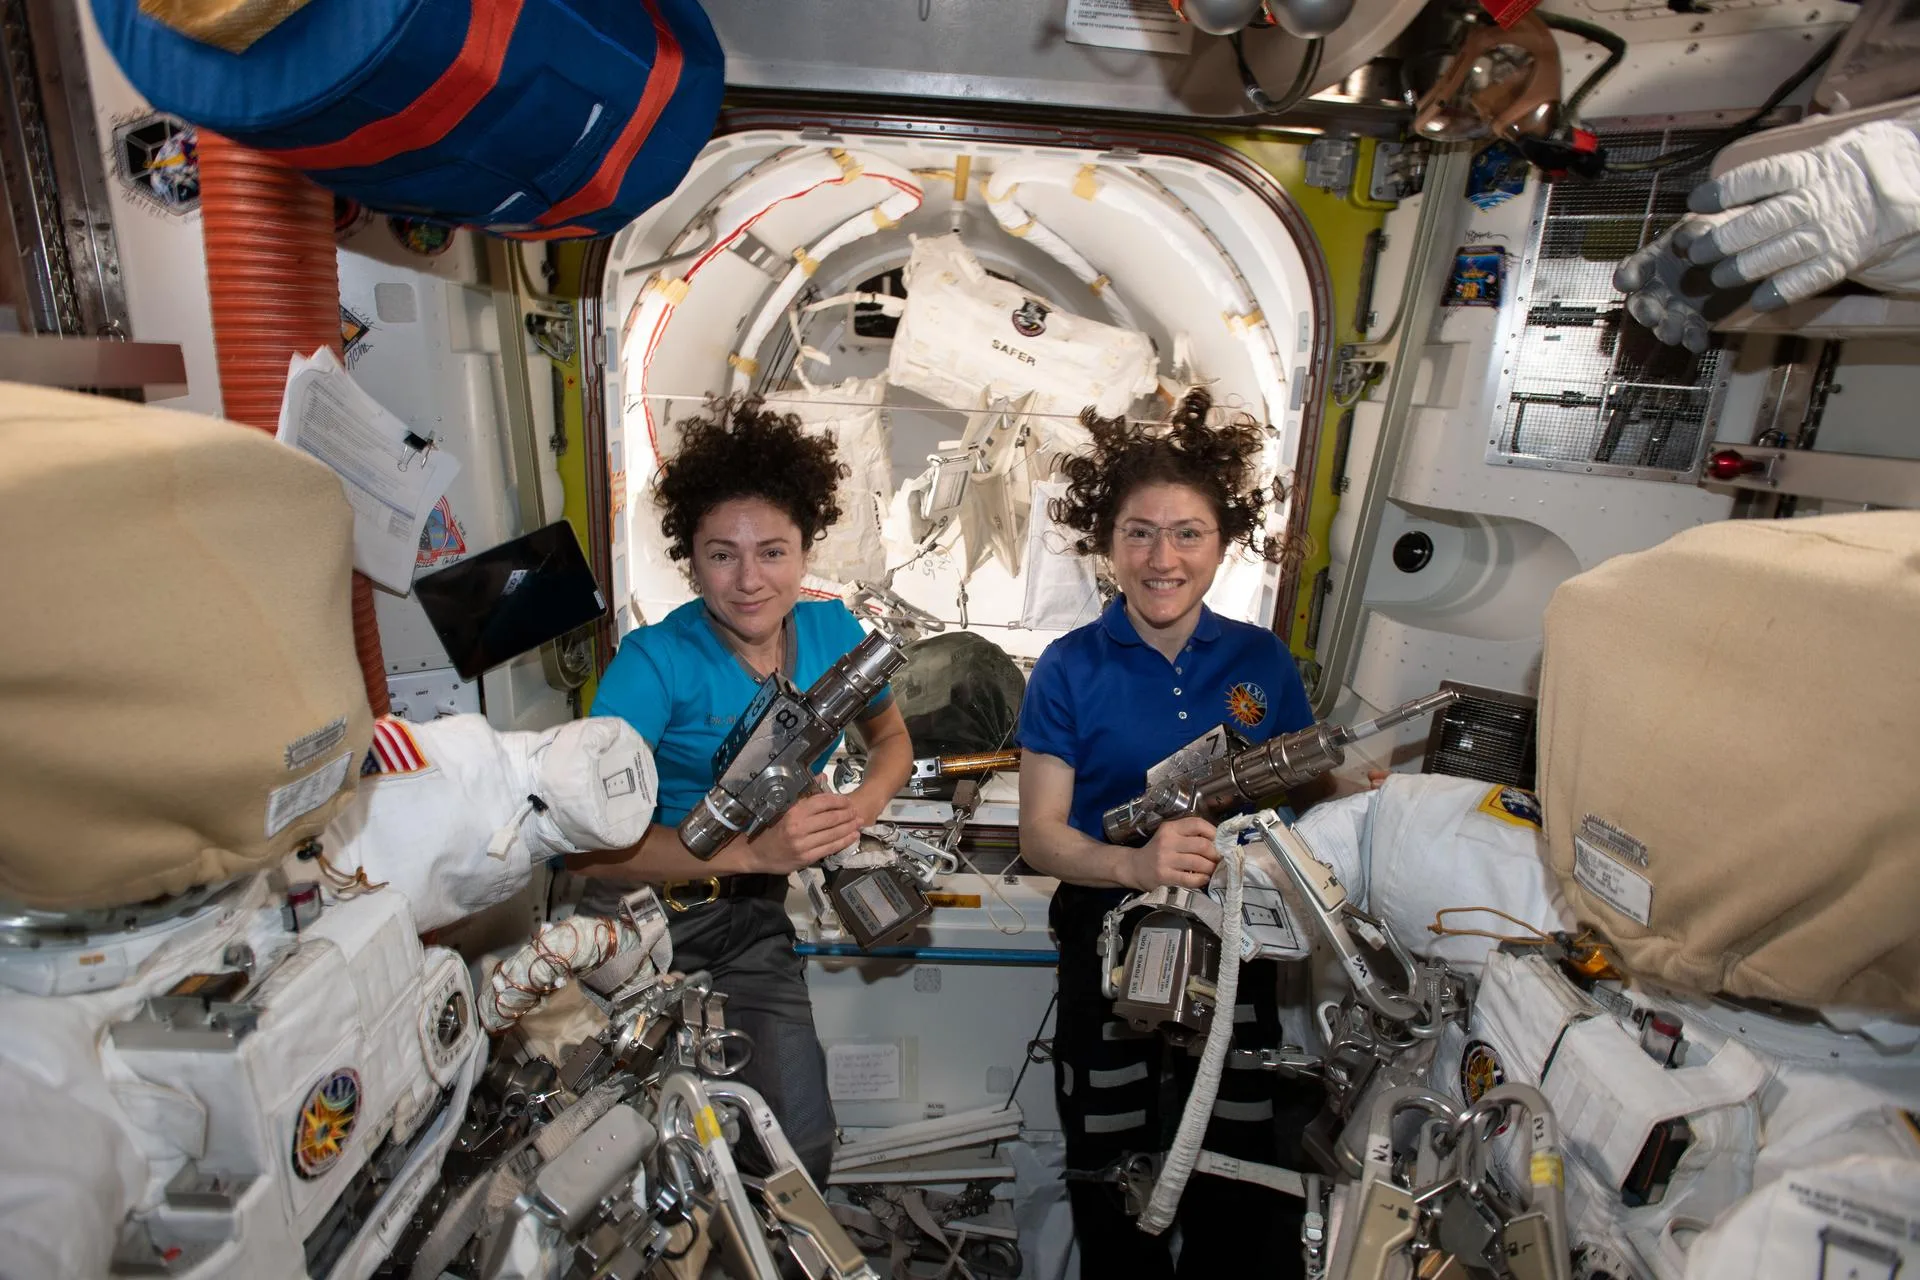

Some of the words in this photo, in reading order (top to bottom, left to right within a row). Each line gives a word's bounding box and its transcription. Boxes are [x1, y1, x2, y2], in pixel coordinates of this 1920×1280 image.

[991, 339, 1037, 367] SAFER
[776, 709, 798, 729] 8
[1206, 733, 1220, 755] 7
[1134, 953, 1143, 979] POWER
[1139, 932, 1149, 951] TOOL
